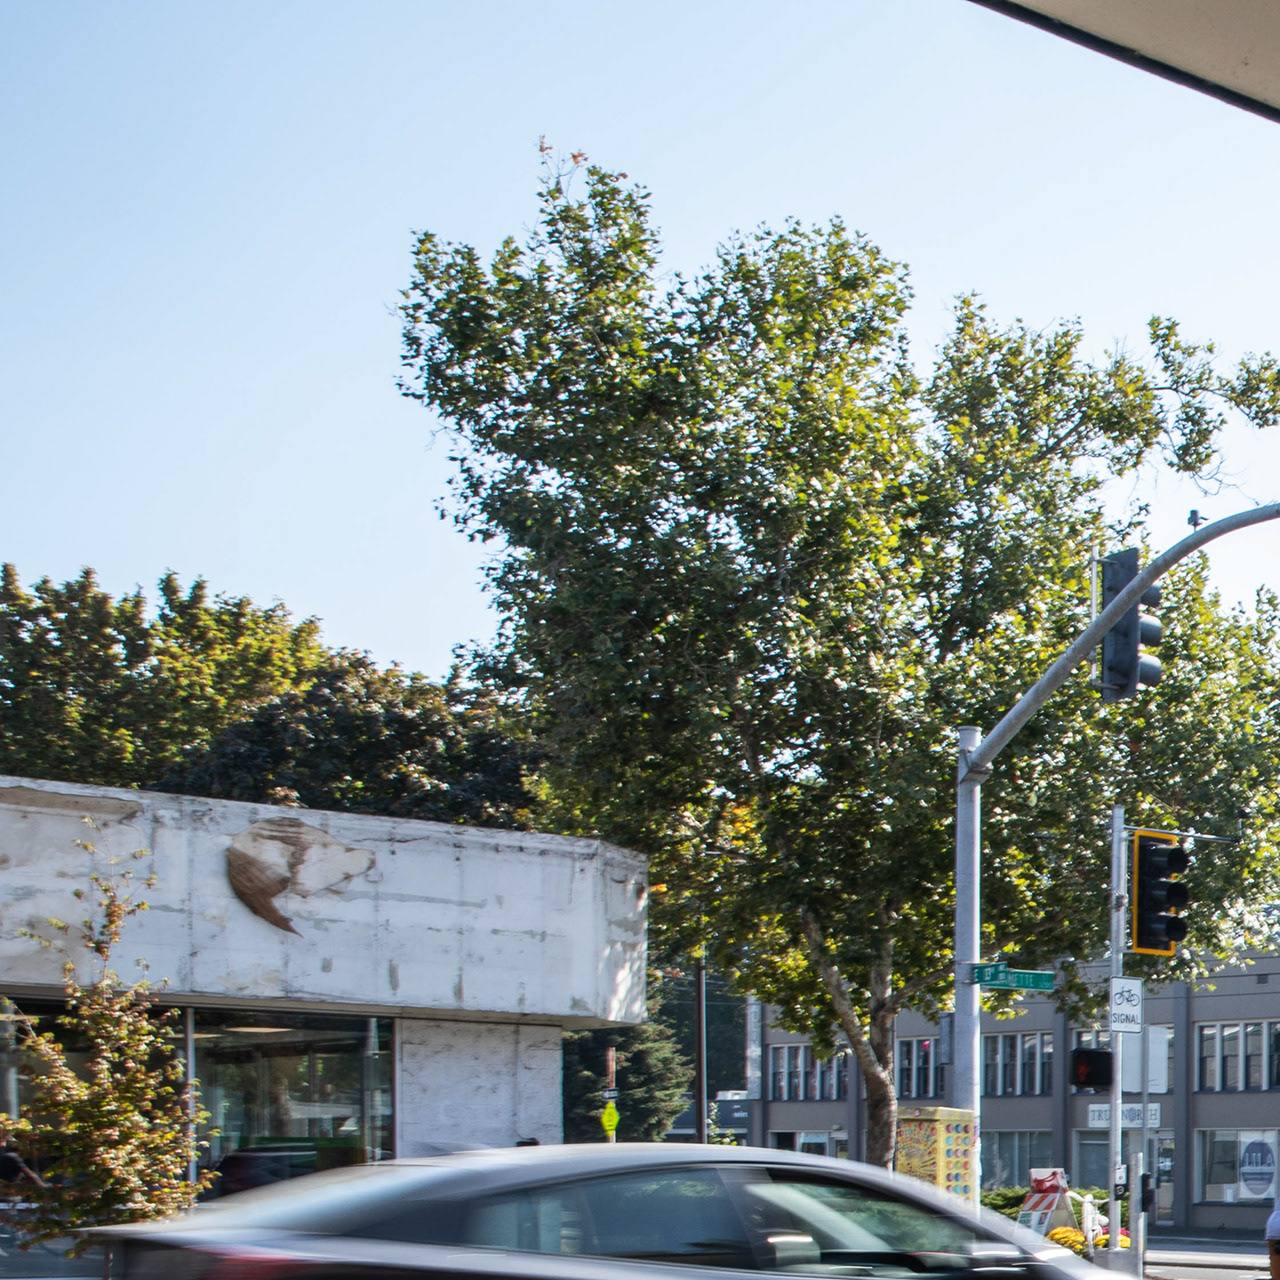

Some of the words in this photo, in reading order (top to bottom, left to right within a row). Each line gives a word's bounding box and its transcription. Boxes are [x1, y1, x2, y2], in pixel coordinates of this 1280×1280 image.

[1112, 1012, 1141, 1025] SIGNAL
[1121, 1107, 1159, 1122] NORH
[1243, 1152, 1275, 1168] LILA
